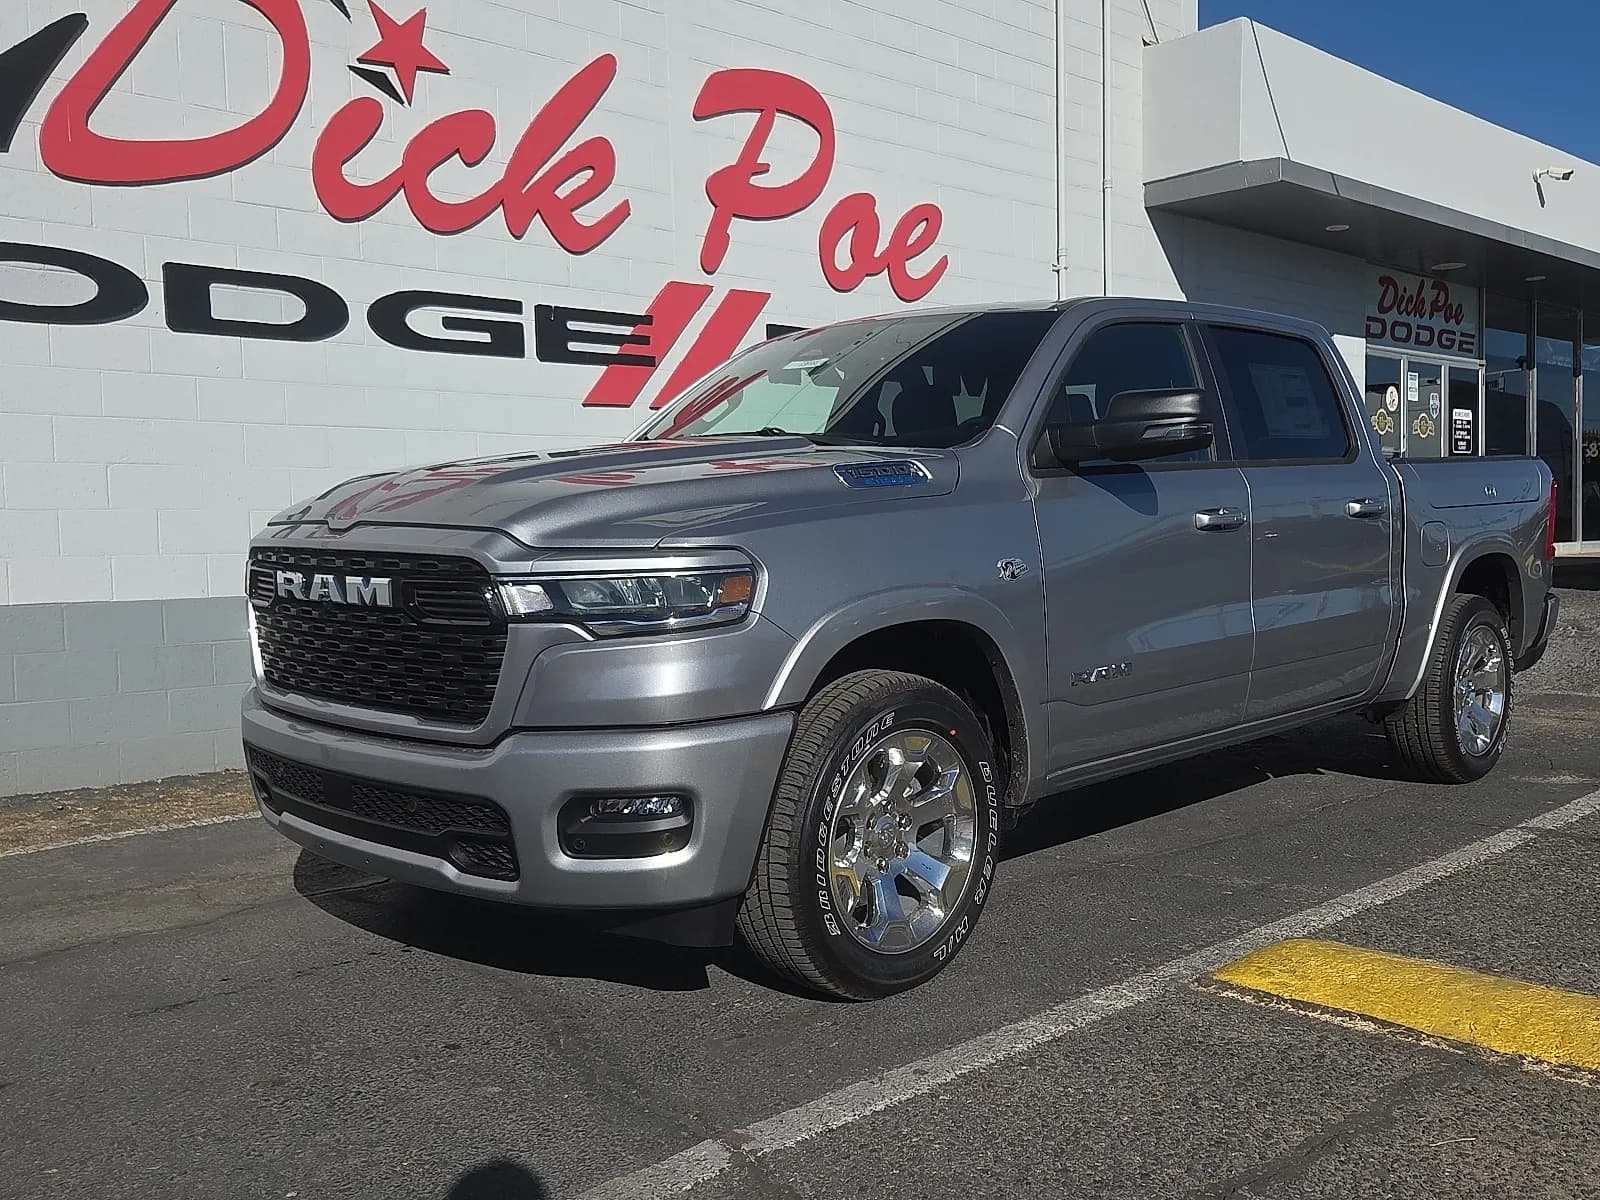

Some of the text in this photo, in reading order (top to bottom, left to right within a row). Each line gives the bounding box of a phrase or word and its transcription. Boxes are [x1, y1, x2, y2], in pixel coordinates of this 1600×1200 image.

[39, 0, 949, 304] Dick Poe
[1365, 315, 1476, 353] DODGE
[1378, 275, 1465, 325] Dick Poe
[276, 570, 393, 609] RAM
[816, 712, 895, 936] BRIDGESTONE
[975, 761, 998, 905] DUELER
